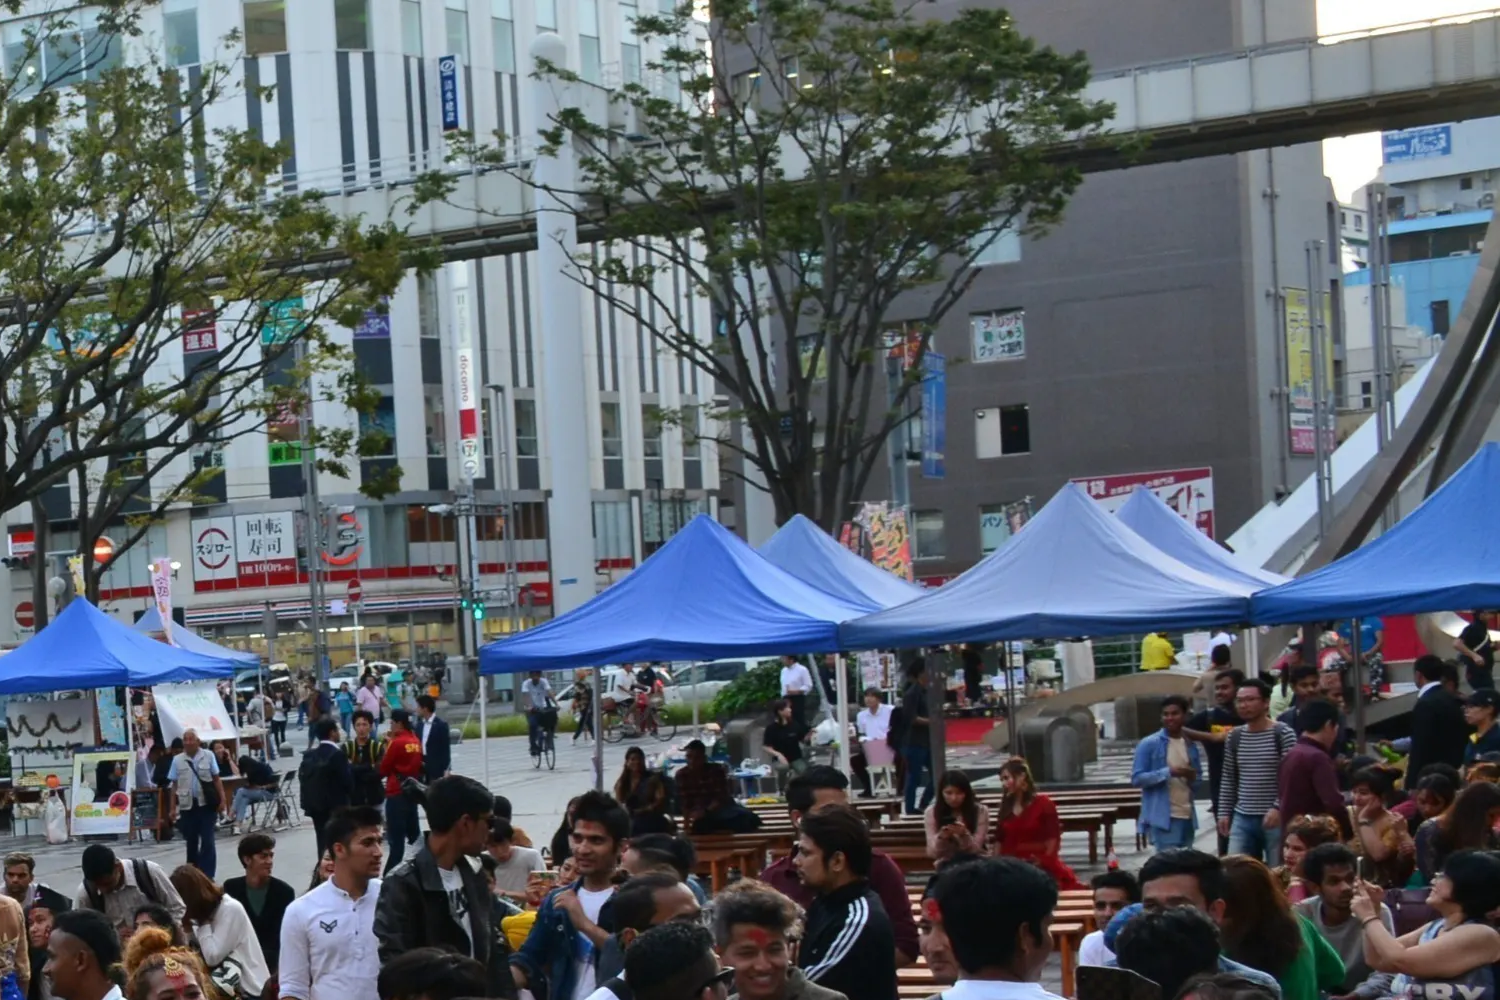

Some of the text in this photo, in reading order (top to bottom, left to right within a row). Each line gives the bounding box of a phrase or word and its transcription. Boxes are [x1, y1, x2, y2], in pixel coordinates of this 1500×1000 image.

[186, 333, 214, 350] 温泉
[459, 355, 469, 402] docomo
[247, 518, 282, 536] 回転
[248, 537, 282, 556] 寿司
